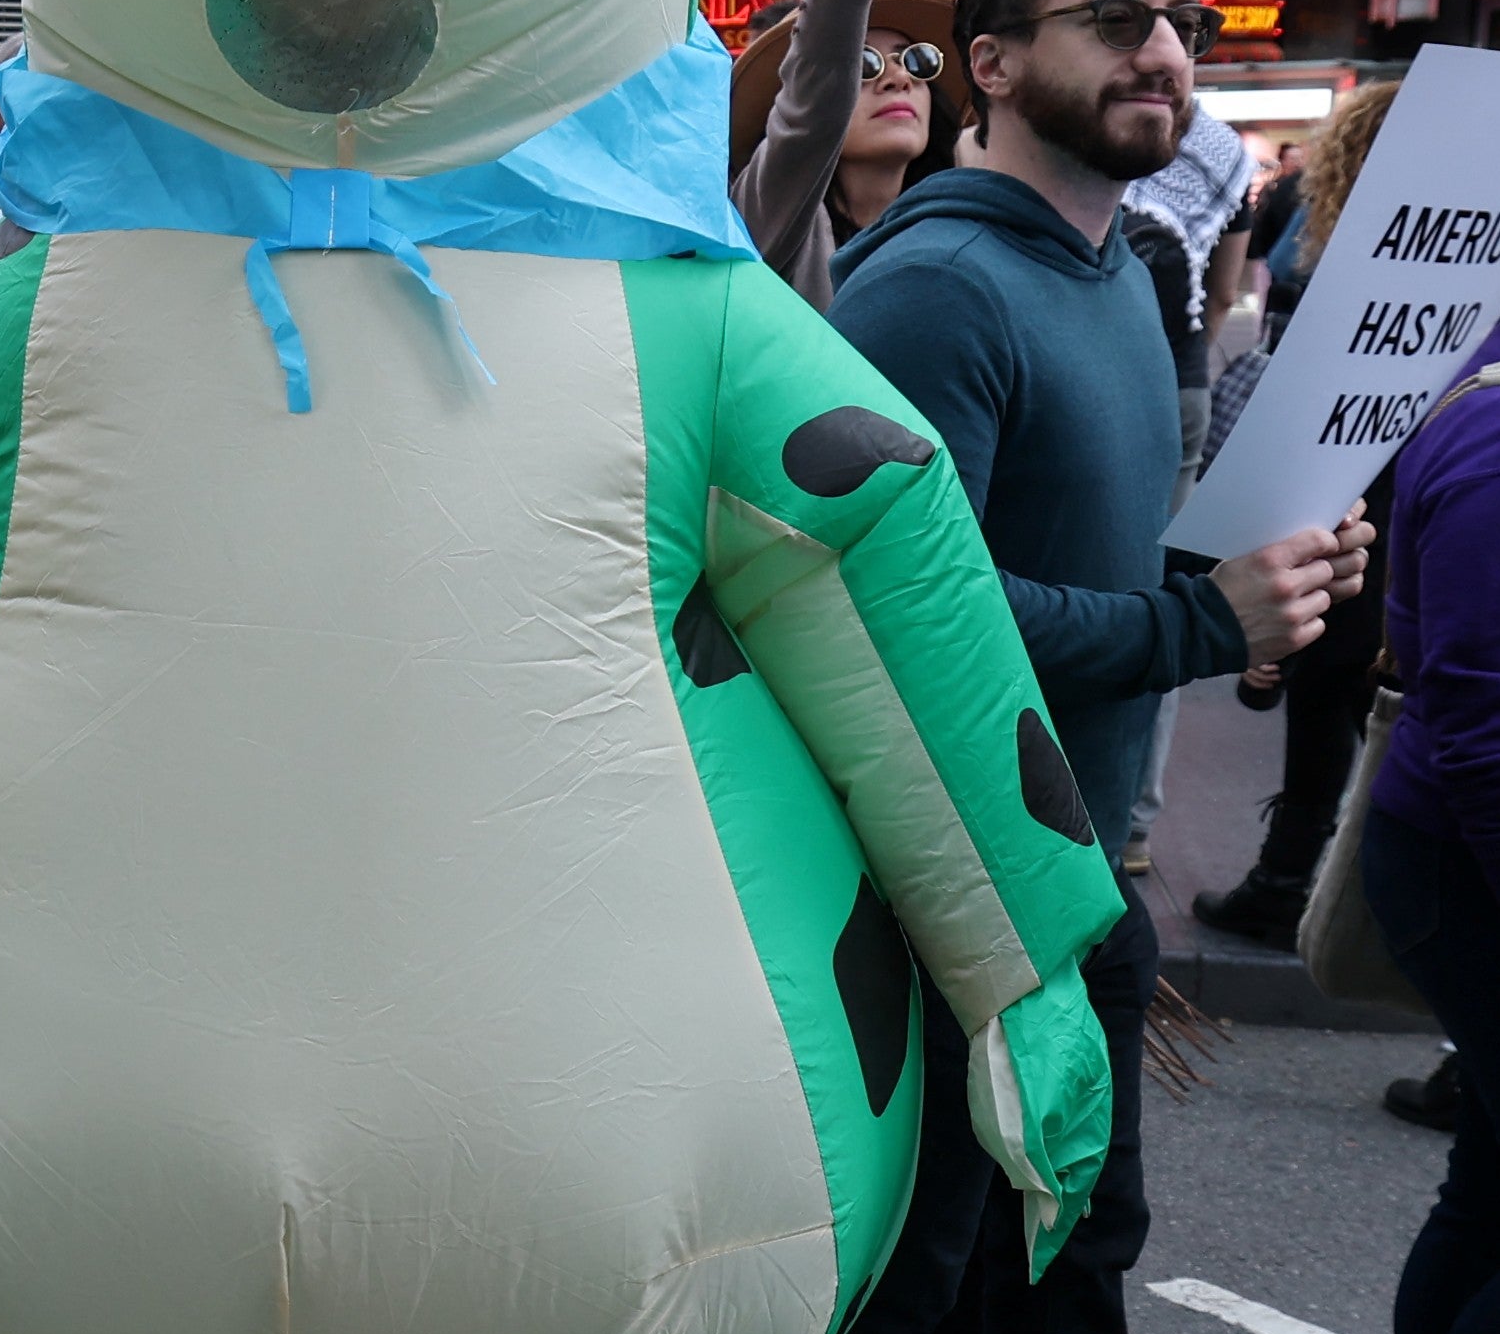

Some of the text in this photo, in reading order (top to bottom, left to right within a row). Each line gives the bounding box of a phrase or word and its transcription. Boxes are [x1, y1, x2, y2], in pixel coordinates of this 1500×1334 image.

[1347, 300, 1483, 357] HAS NO
[1317, 389, 1429, 446] KINGS
